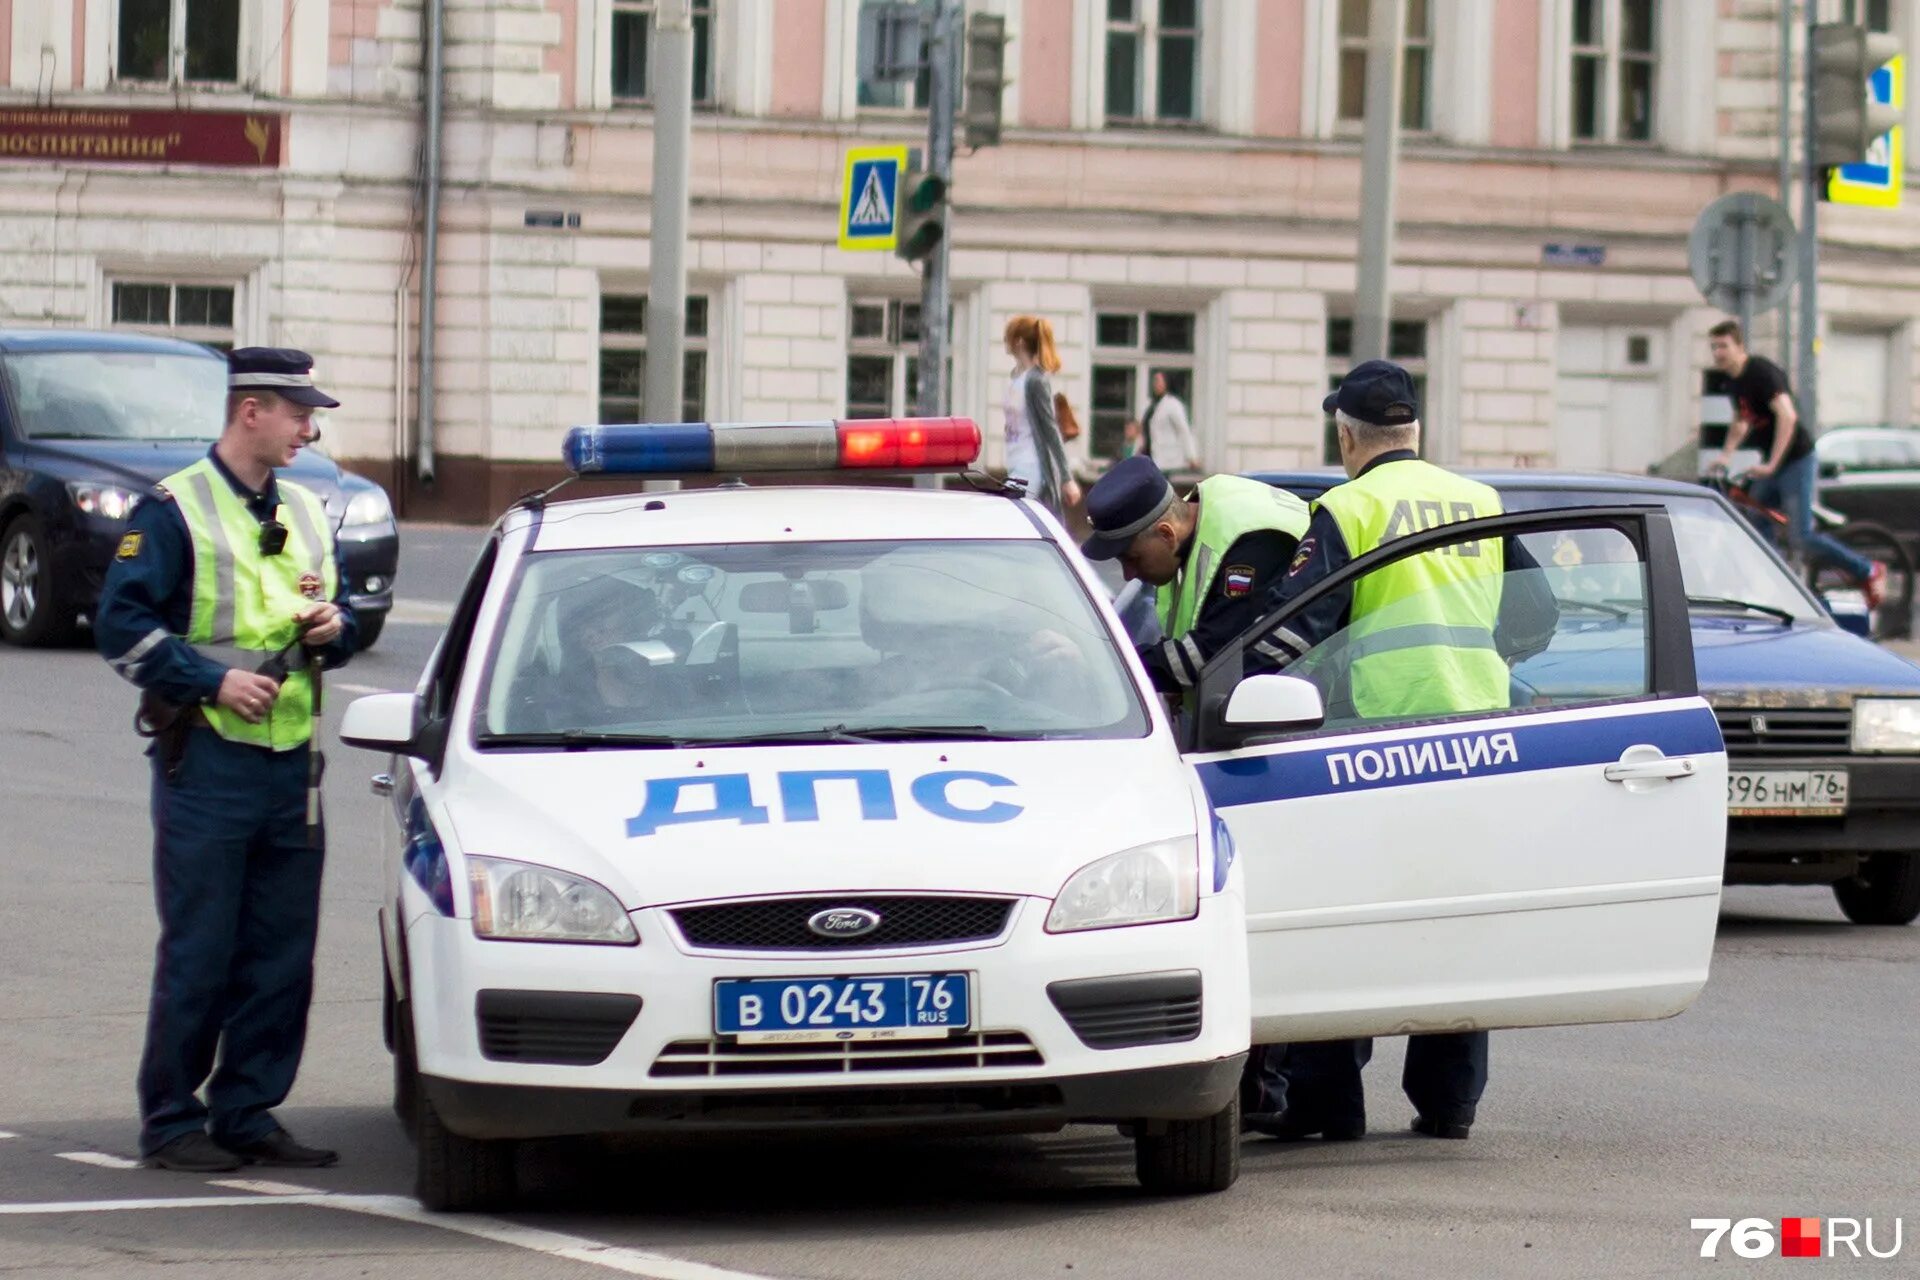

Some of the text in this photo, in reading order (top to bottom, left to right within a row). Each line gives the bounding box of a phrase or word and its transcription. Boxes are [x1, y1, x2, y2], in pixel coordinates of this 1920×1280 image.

[1326, 732, 1519, 785] ПОЛИЦИЯ
[625, 769, 1025, 838] ДПС
[1774, 782, 1806, 801] НМ
[1814, 774, 1838, 794] 76
[824, 913, 862, 930] Ford
[739, 979, 952, 1026] В 0243 76
[917, 1011, 948, 1023] RUS
